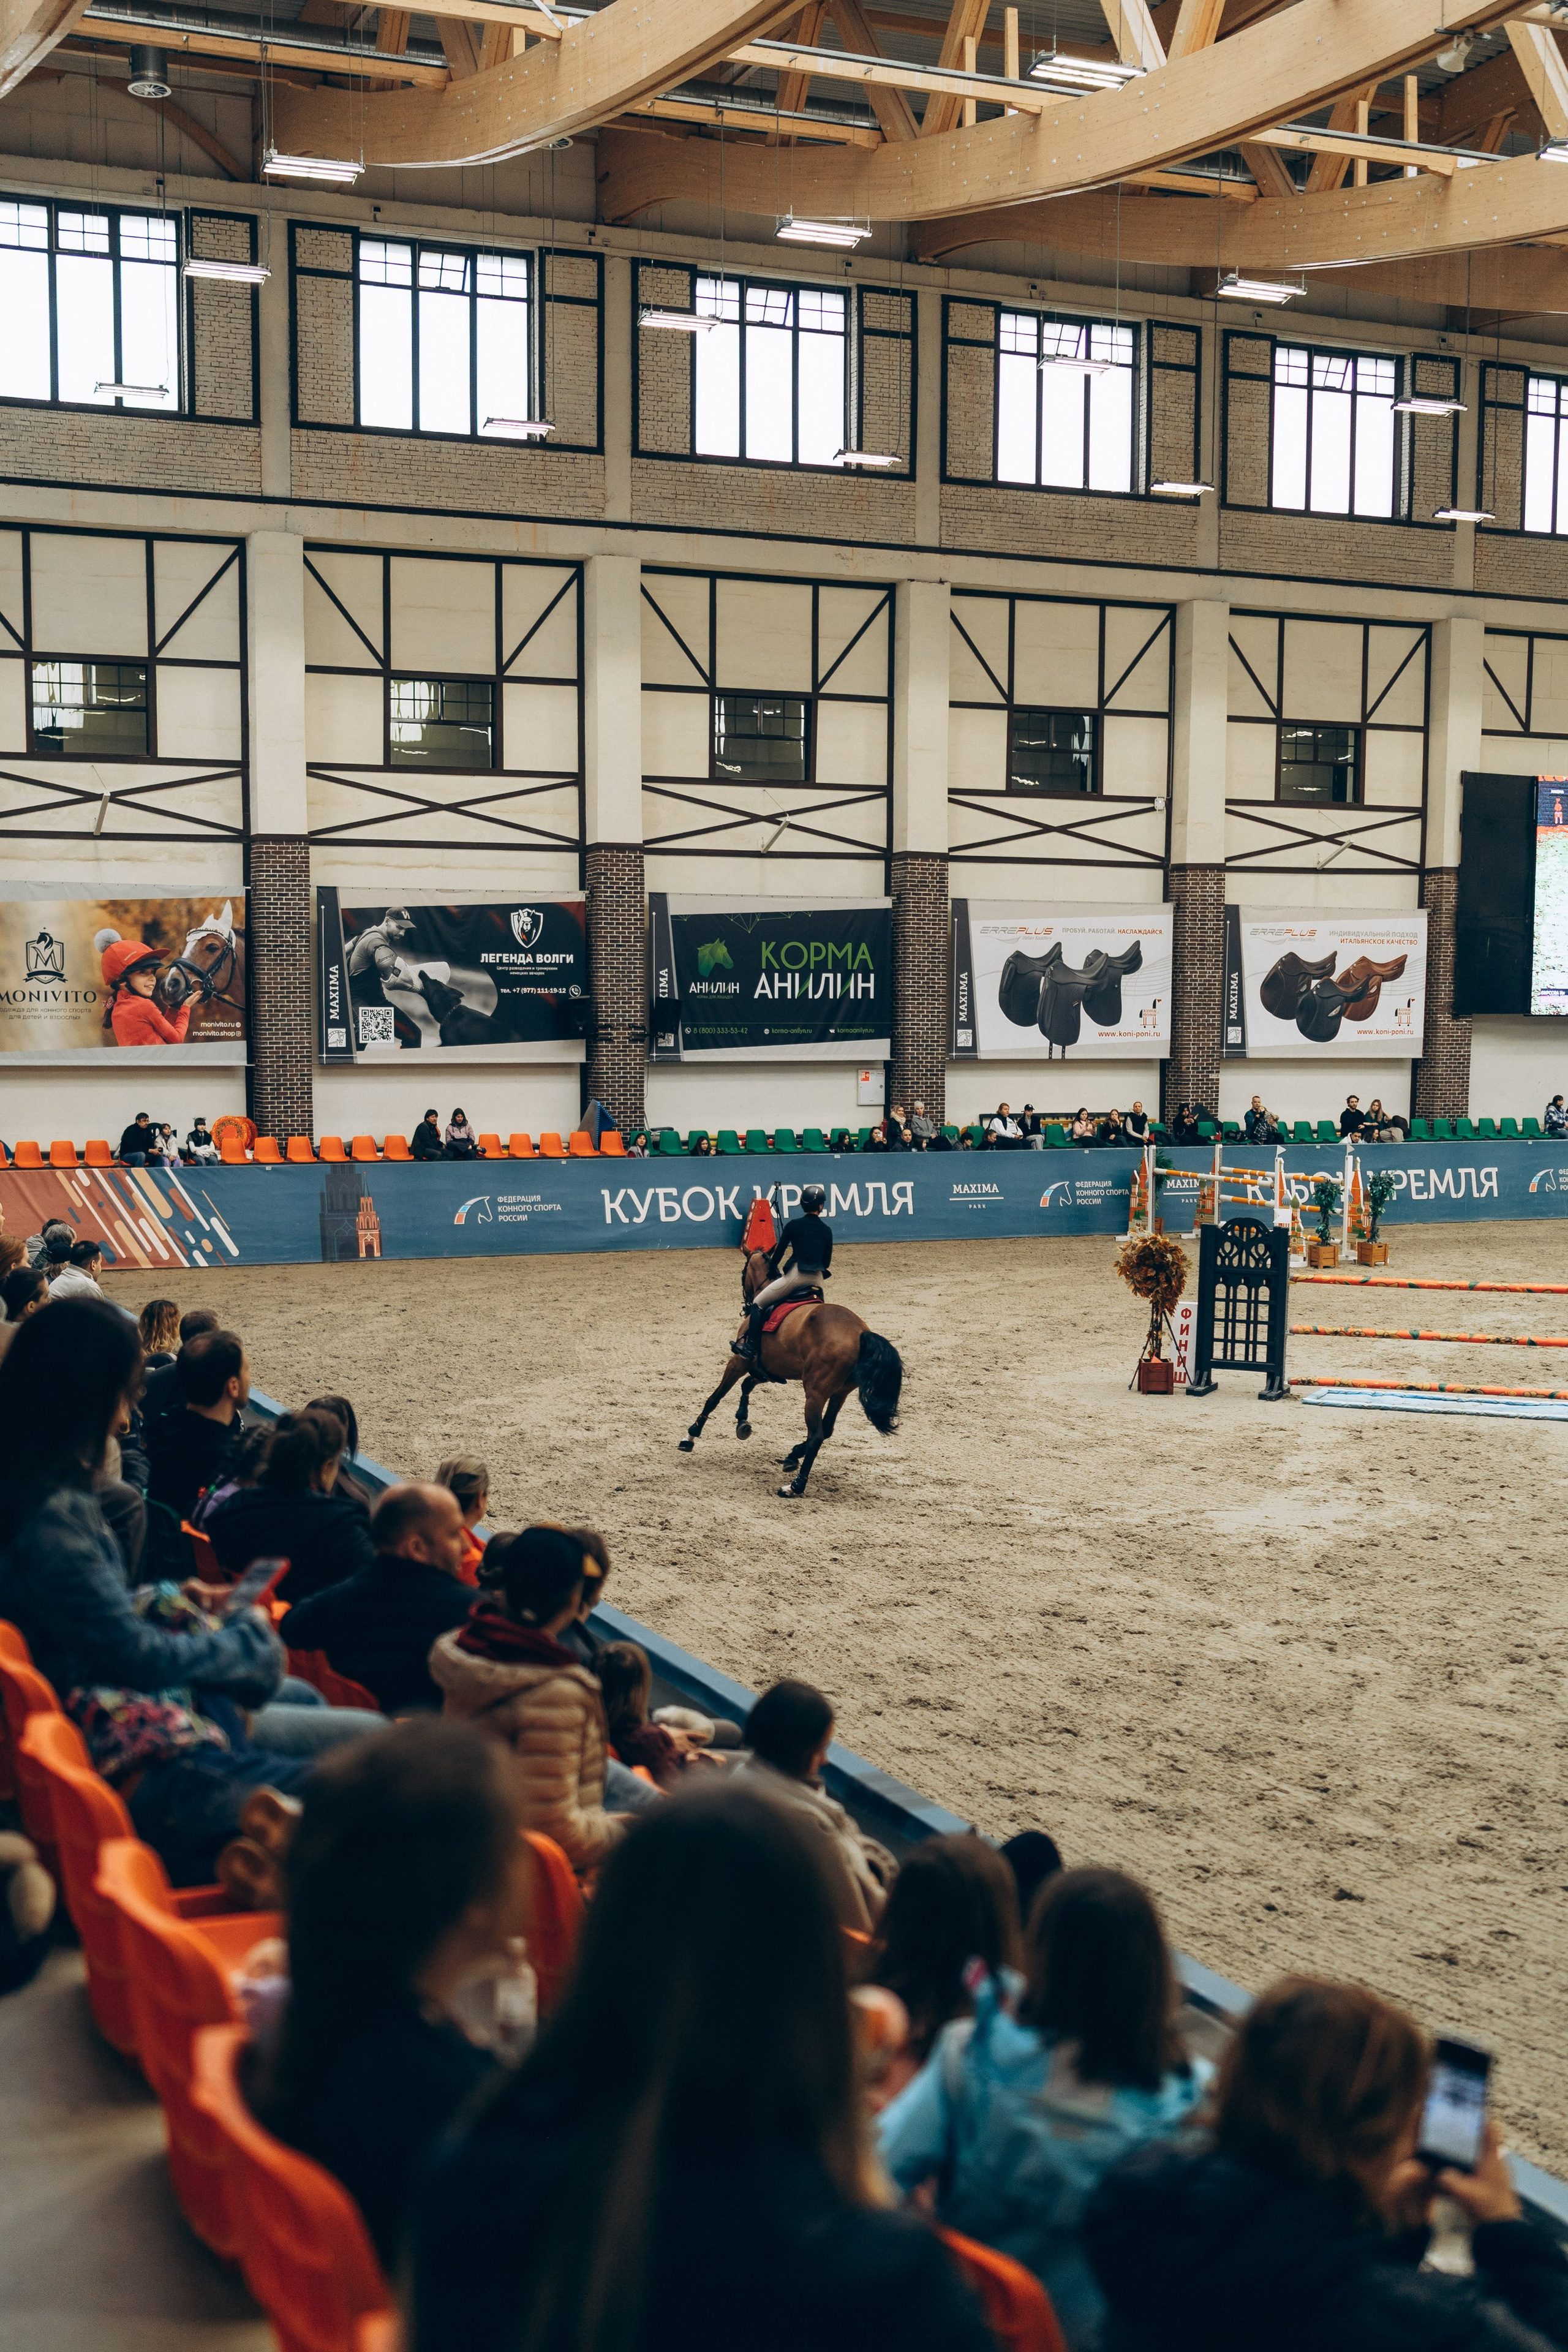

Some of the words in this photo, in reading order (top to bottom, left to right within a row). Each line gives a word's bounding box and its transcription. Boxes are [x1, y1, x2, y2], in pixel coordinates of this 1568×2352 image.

[480, 953, 533, 965] ЛЕГЕНДА
[536, 954, 574, 963] ВОЛГИ
[761, 941, 874, 970] КОРМА
[330, 964, 339, 1020] MAXIMA
[689, 982, 739, 993] АНИЛИН
[753, 972, 875, 999] АНИЛИН
[959, 971, 968, 1022] MAXIMA
[1229, 971, 1238, 1020] MAXIMA
[1098, 1030, 1161, 1039] www.koni-poni.ru
[1357, 1028, 1414, 1036] www.koni-poni.ru
[952, 1183, 1000, 1194] MAXIMA
[497, 1195, 541, 1204] ФЕДЕРАЦИЯ
[498, 1204, 532, 1213] КОННОГО
[601, 1185, 743, 1224] КУБОК
[1174, 1308, 1192, 1384] ФИНИШ
